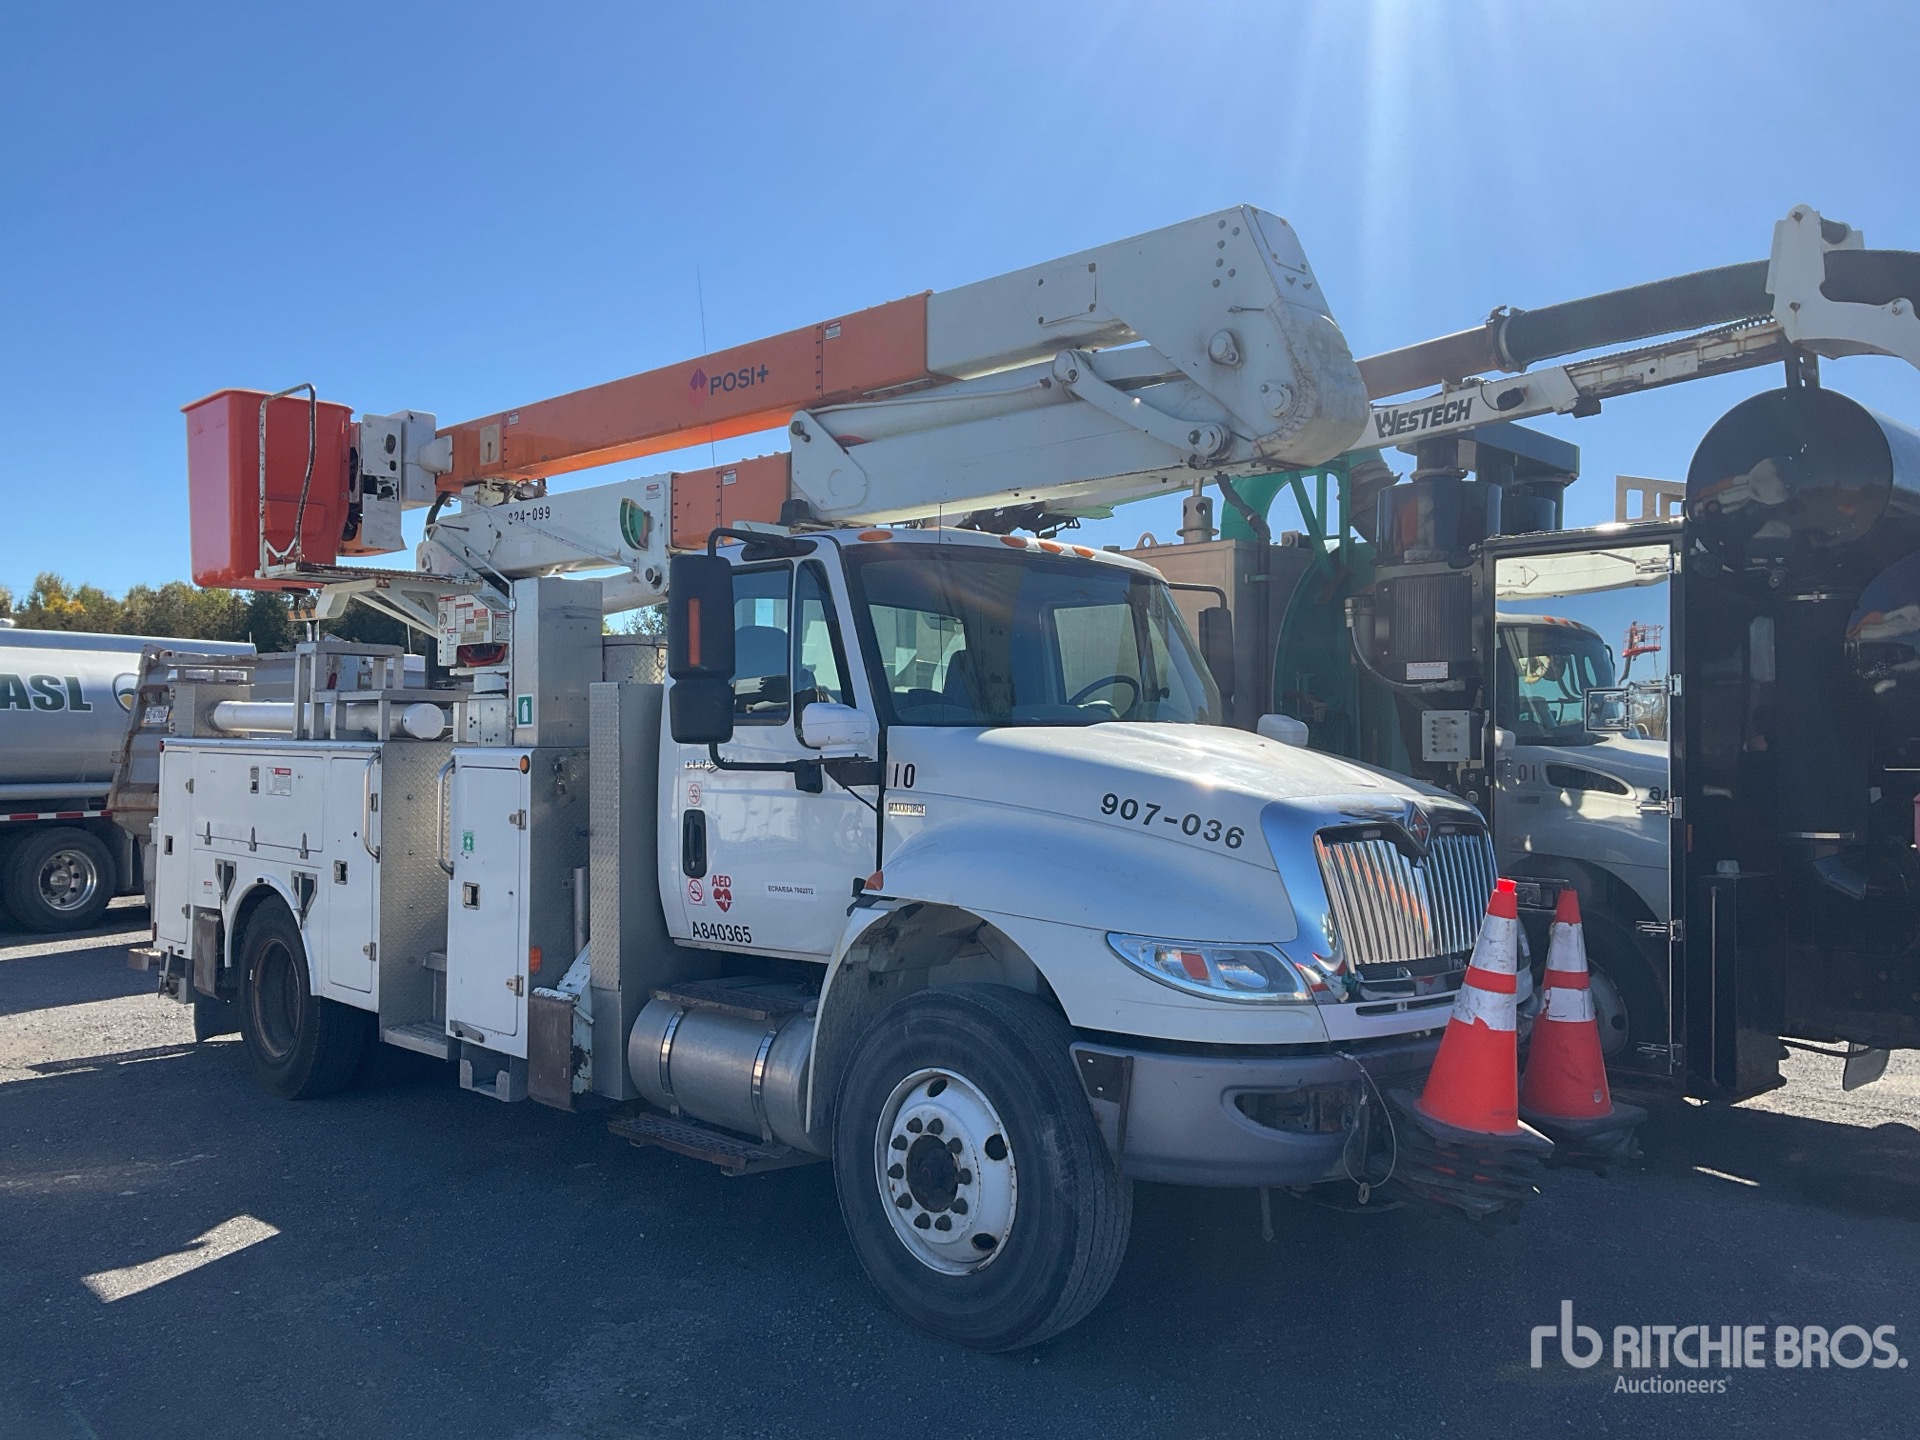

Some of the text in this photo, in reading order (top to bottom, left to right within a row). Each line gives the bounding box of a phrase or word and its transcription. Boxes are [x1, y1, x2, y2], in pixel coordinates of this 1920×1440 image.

[710, 364, 769, 396] POSI+
[1374, 397, 1473, 438] WESTECH
[0, 673, 92, 711] ASL
[893, 763, 916, 789] 10
[1100, 792, 1245, 849] 907-036
[711, 875, 732, 888] AED
[692, 921, 752, 944] A840365
